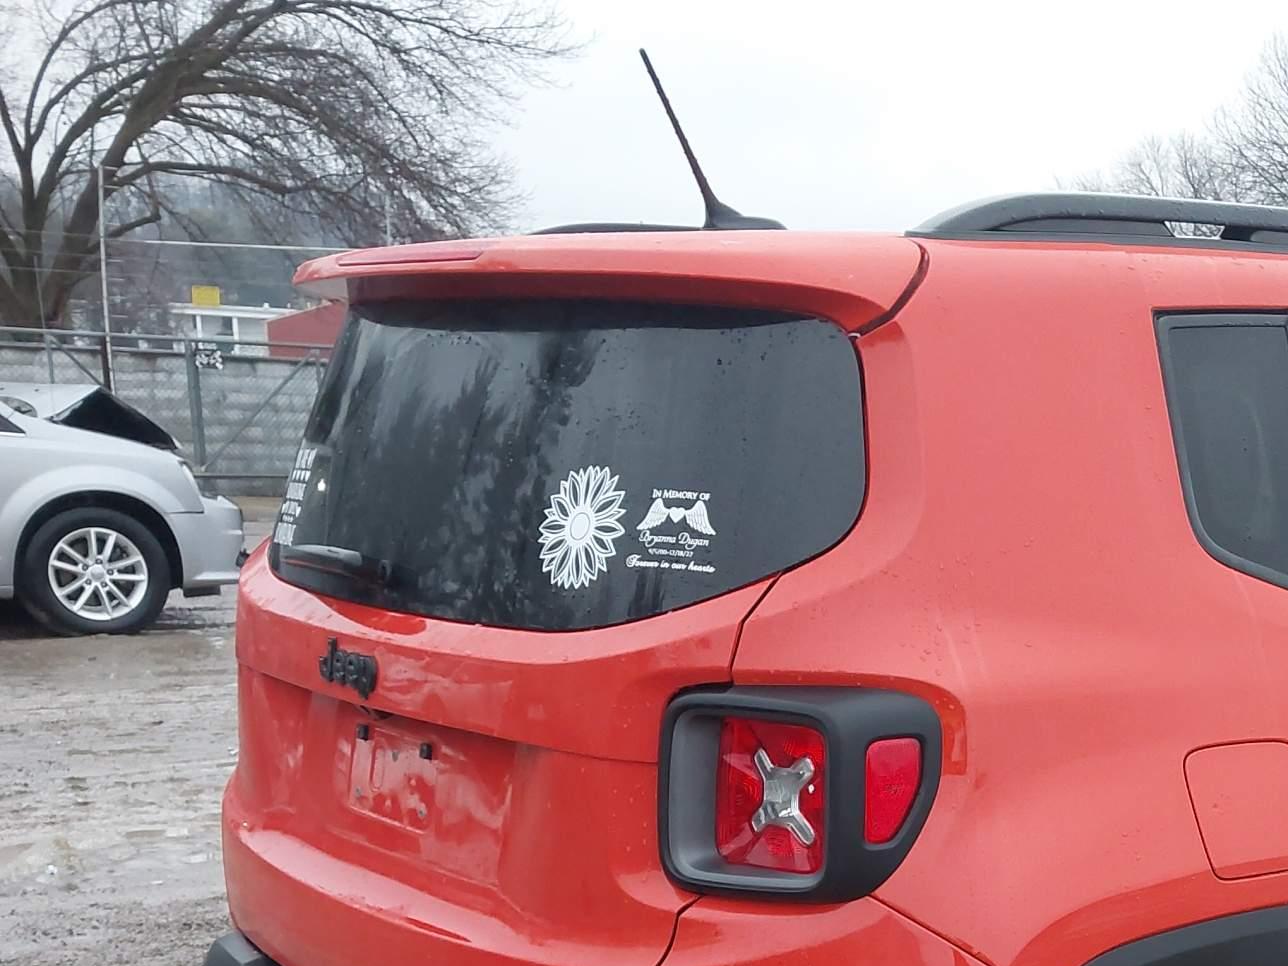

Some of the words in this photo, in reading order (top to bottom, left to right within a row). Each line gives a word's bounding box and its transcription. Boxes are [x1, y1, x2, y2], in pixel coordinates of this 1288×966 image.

[652, 488, 662, 498] IN
[663, 489, 698, 500] MEMORY
[319, 636, 378, 700] Jeep
